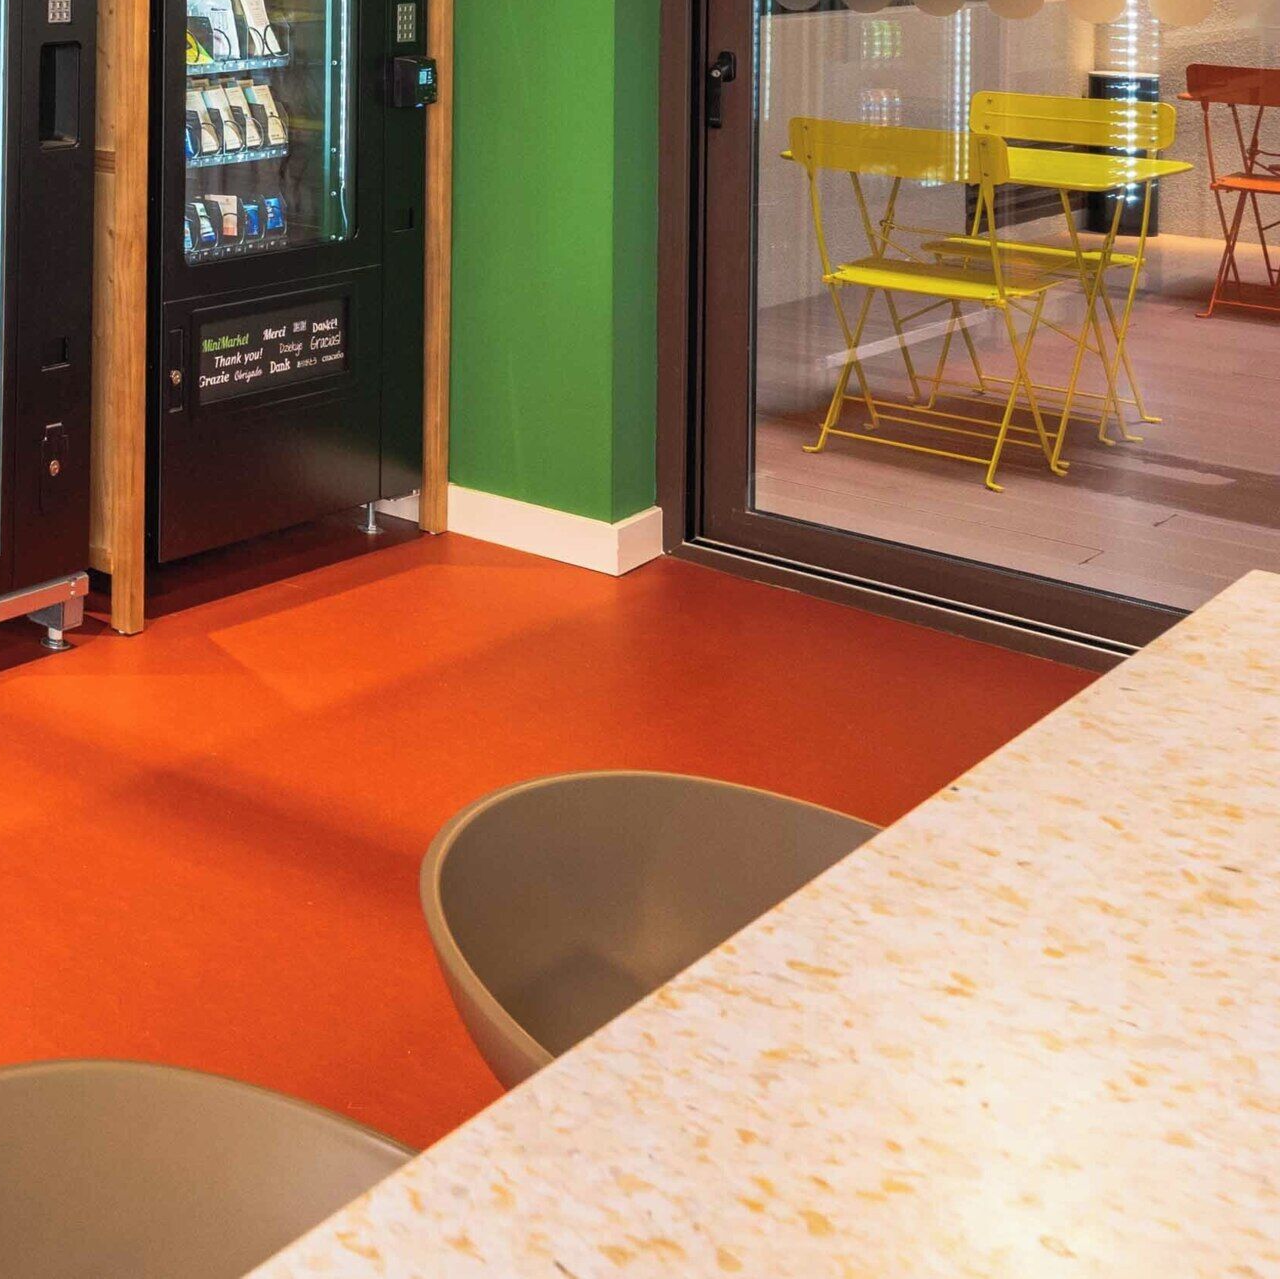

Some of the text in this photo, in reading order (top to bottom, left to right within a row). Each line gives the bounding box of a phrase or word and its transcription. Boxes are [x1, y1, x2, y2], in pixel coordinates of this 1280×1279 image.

[263, 326, 287, 341] Merci
[202, 333, 250, 352] MiniMarket
[214, 348, 264, 369] Thank you!
[270, 358, 291, 374] Dank
[199, 371, 230, 388] Grazie
